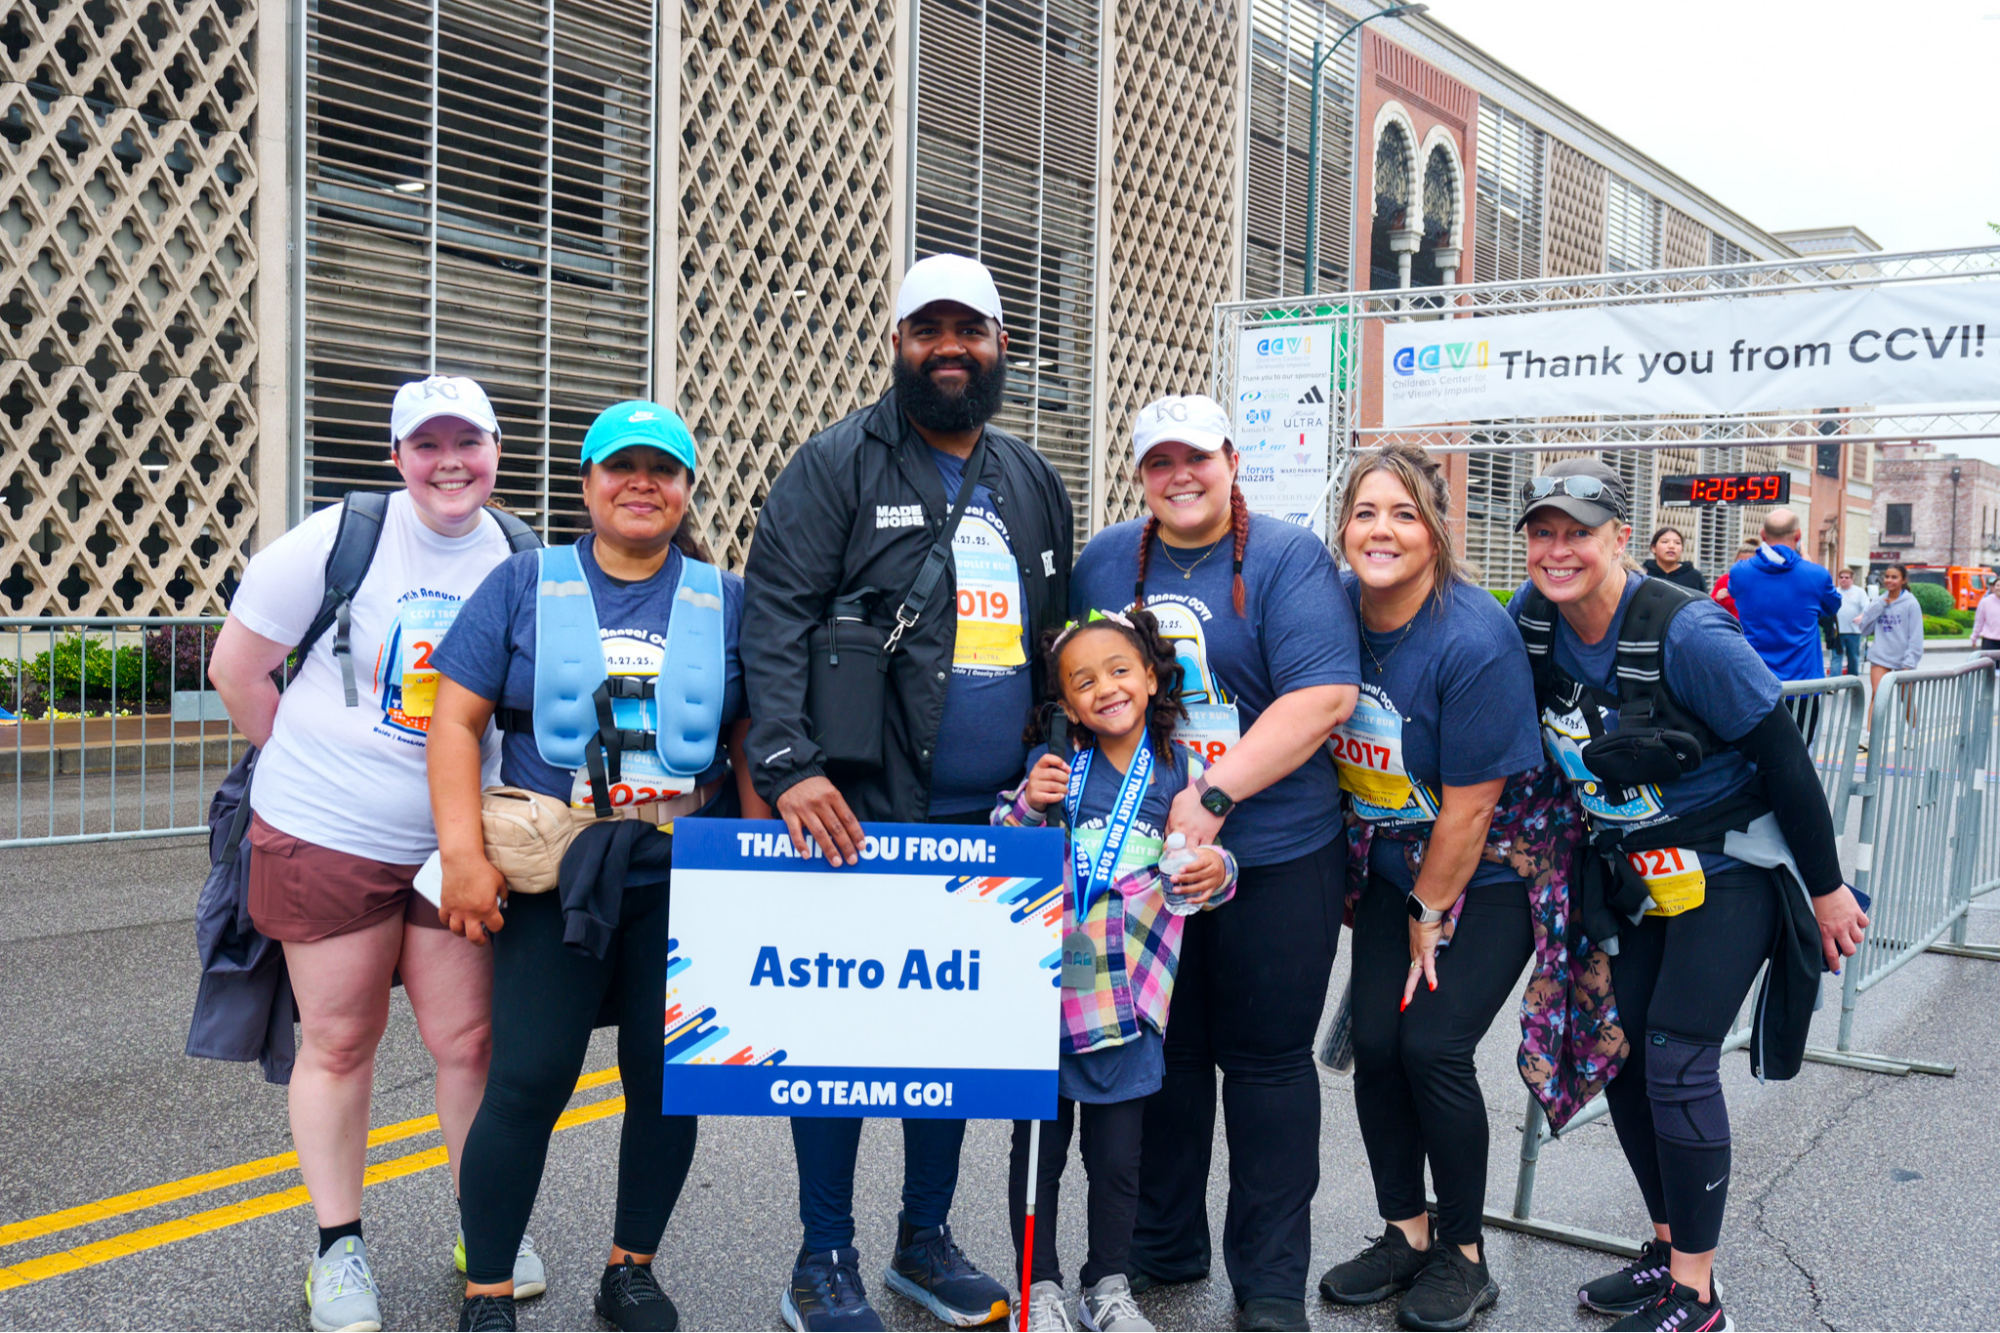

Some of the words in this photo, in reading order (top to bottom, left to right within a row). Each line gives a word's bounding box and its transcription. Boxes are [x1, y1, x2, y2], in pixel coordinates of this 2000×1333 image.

[1393, 340, 1489, 376] CCVI
[1500, 346, 1624, 380] Thank
[1638, 350, 1713, 383] you
[1730, 339, 1831, 373] from
[1848, 324, 1985, 363] CCVI!
[1295, 371, 1327, 380] sponsors!
[1392, 377, 1437, 389] Children's
[1439, 374, 1472, 385] Center
[1474, 373, 1487, 382] for
[422, 380, 459, 400] KC
[1392, 391, 1405, 401] the
[1408, 387, 1442, 399] Visually
[1444, 384, 1487, 397] Impaired
[634, 410, 655, 418] NIKE
[1156, 399, 1188, 423] KC
[1283, 417, 1324, 428] ULTRA
[1238, 474, 1275, 482] mazars
[876, 504, 923, 517] MADE
[876, 515, 925, 529] MOBB
[993, 561, 1011, 571] RUN
[956, 589, 1009, 619] 019
[1147, 593, 1190, 605] Annual
[410, 609, 436, 619] CCVI
[599, 628, 648, 640] Annual
[1209, 711, 1230, 720] RUN
[1376, 717, 1395, 728] RUN
[1329, 733, 1391, 771] 2017
[1069, 773, 1083, 797] RUN
[1116, 775, 1142, 824] TROLLEY
[1371, 794, 1392, 805] ULTRA
[1106, 823, 1126, 849] RUN
[858, 836, 900, 860] OU
[905, 836, 998, 863] FROM:
[1075, 845, 1090, 878] 2025
[1095, 850, 1116, 881] 2025
[1628, 847, 1686, 878] 021
[1664, 905, 1686, 913] ULTRA
[750, 946, 885, 990] Astro
[897, 949, 980, 991] Adi
[770, 1080, 812, 1105] GO
[817, 1081, 897, 1106] TEAM
[903, 1082, 953, 1107] GO!
